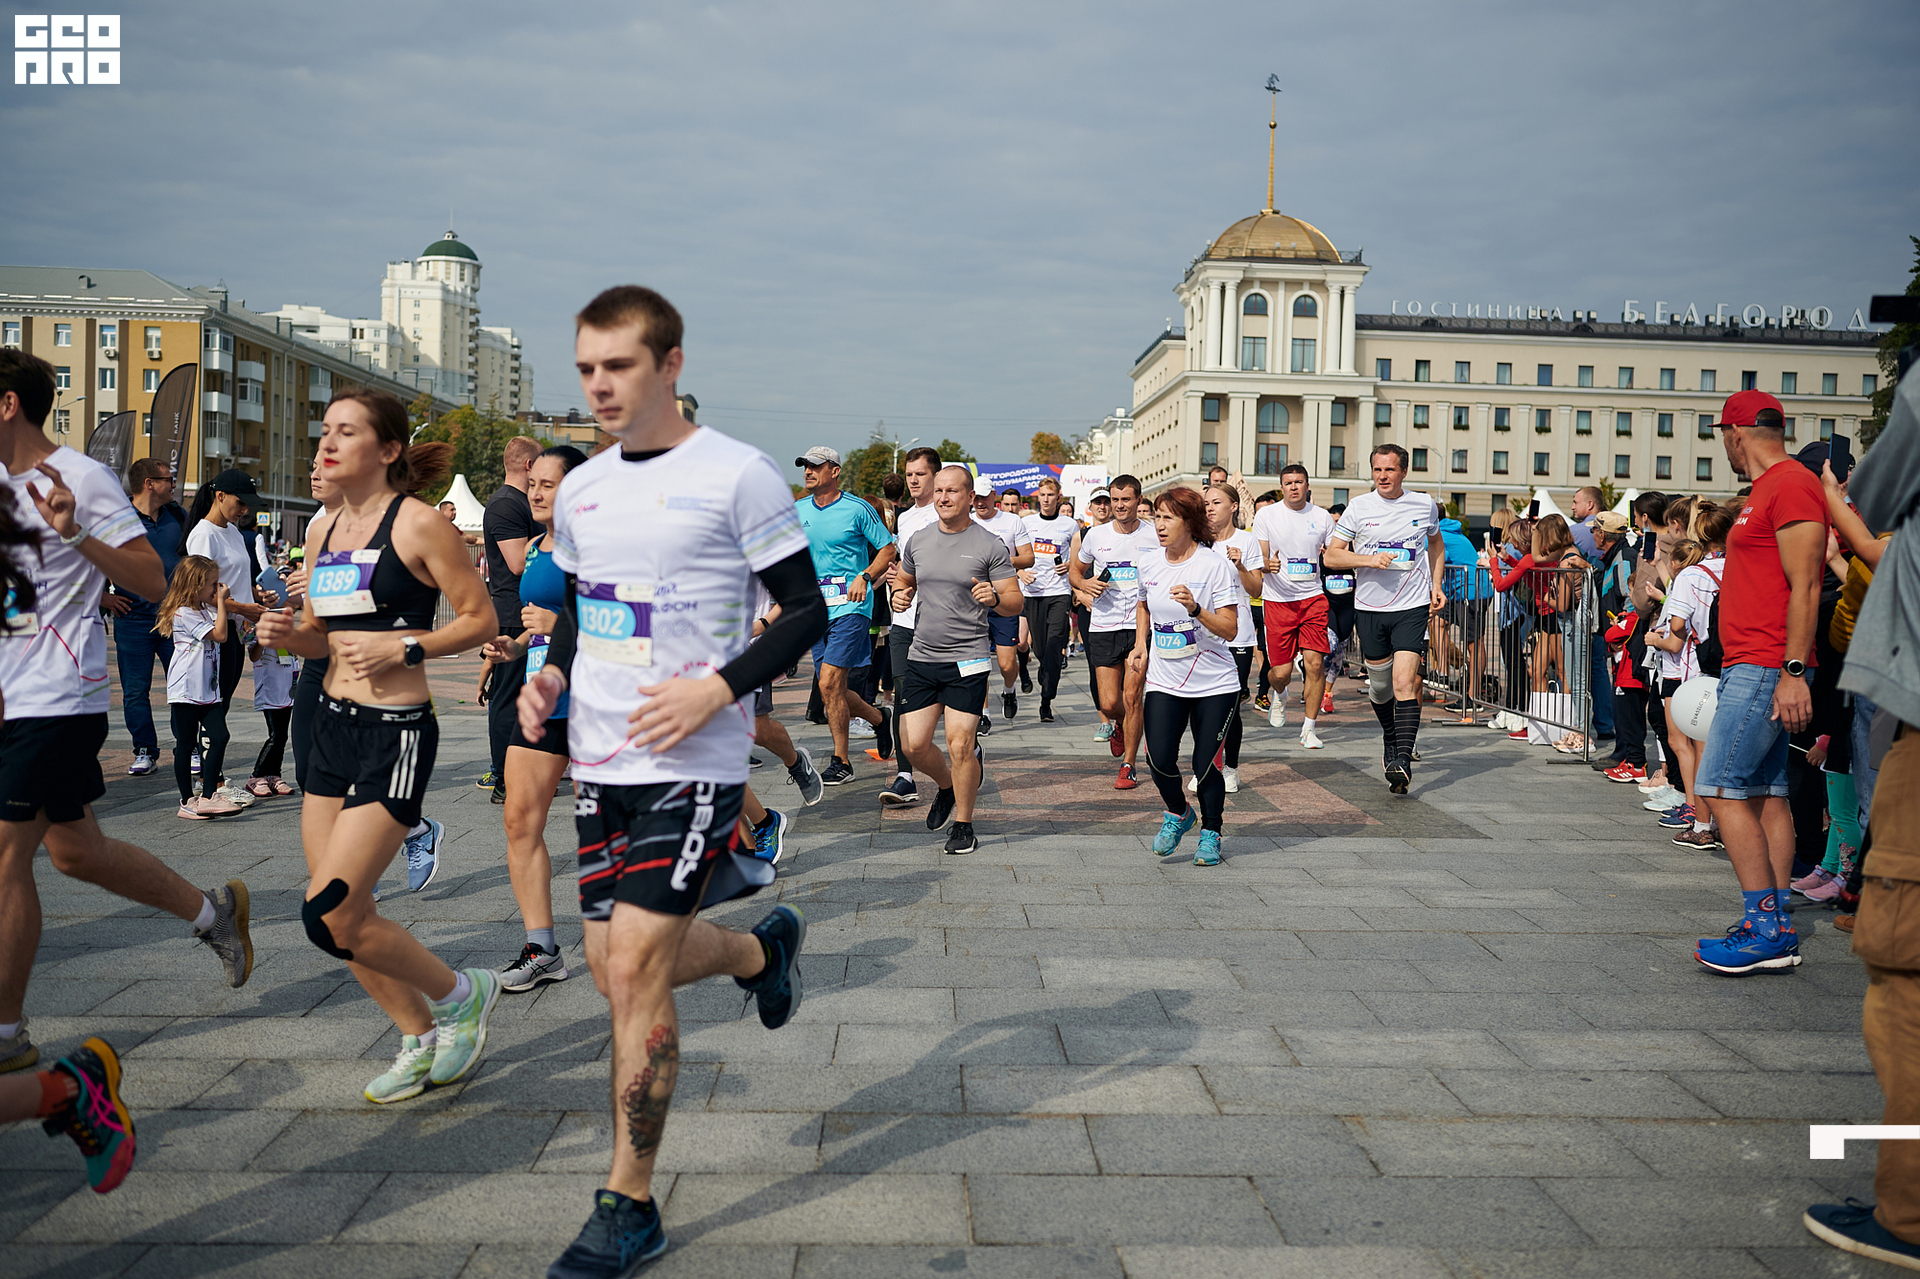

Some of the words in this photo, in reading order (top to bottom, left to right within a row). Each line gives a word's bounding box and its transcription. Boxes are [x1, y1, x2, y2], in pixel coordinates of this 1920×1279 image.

[1391, 300, 1563, 320] ГОСТИНИЦА
[1623, 300, 1868, 330] БЕЛГОРОД
[1035, 543, 1056, 553] 5413
[1111, 569, 1136, 579] 1446
[1291, 564, 1311, 574] 1039
[316, 568, 357, 594] 1389
[1329, 581, 1345, 589] 1122
[581, 603, 626, 636] 1302
[1156, 634, 1182, 647] 1074
